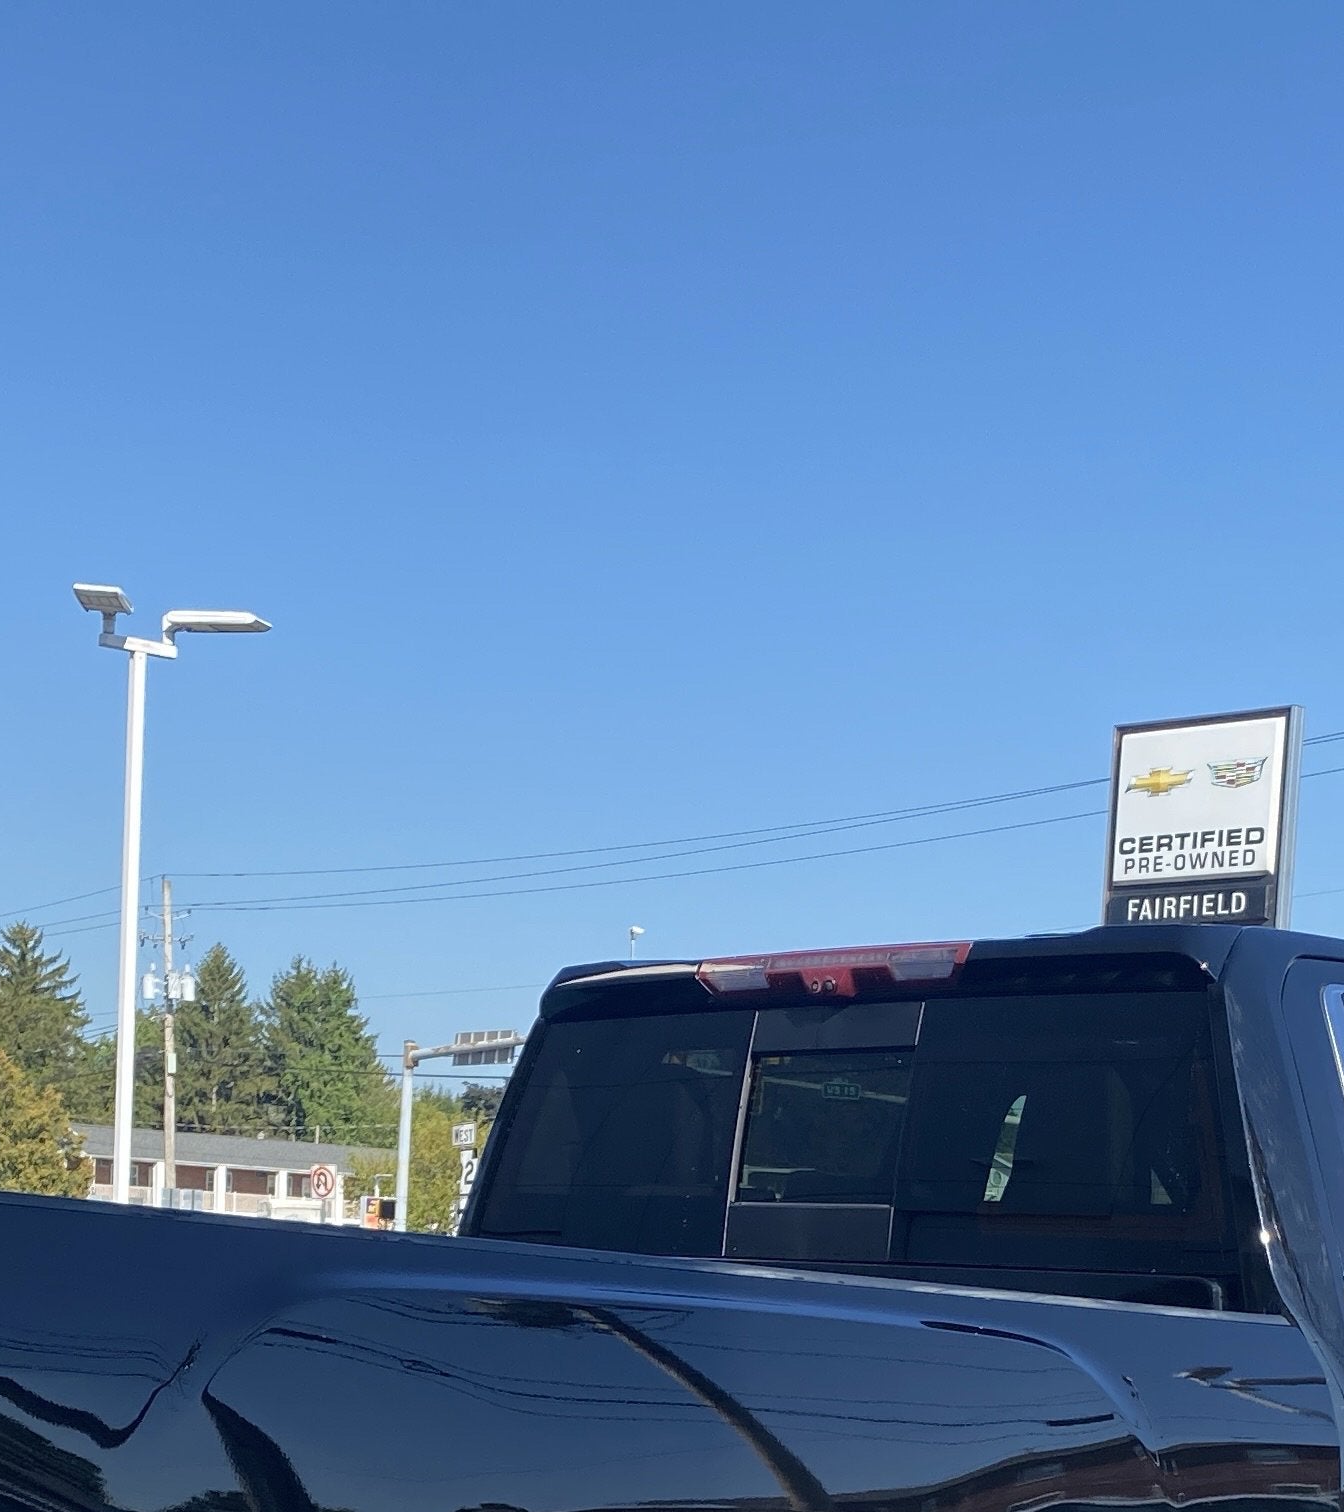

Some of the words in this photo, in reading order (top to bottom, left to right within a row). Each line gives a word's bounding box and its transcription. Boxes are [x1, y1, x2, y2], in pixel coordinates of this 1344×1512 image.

[1118, 827, 1265, 855] CERTIFIED
[1124, 849, 1256, 875] PRE-OWNED
[1127, 892, 1246, 921] FAIRFIELD
[455, 1128, 474, 1142] WEST
